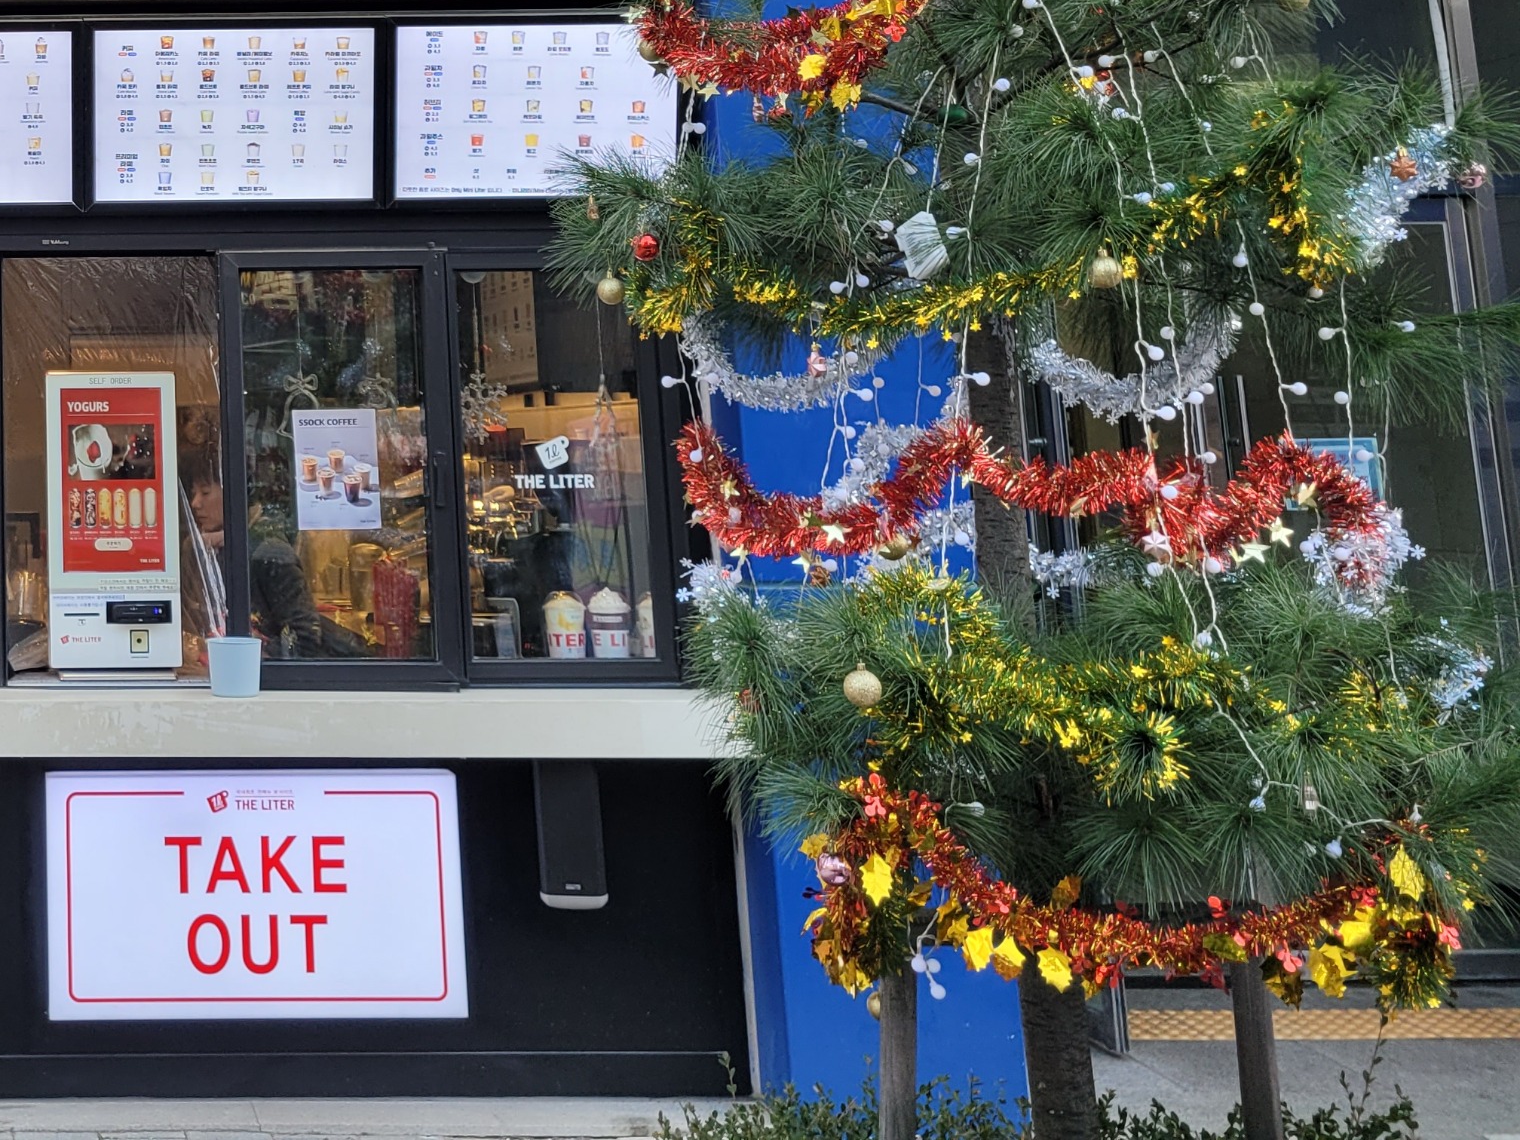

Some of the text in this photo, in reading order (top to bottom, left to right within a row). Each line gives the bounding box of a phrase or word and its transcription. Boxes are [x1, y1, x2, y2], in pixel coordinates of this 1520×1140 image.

[89, 377, 106, 385] SELF
[67, 401, 109, 412] YOGURS
[514, 474, 595, 489] THE LITER
[235, 800, 295, 810] THE LITER
[164, 835, 349, 894] TAKE
[186, 913, 329, 975] OUT
